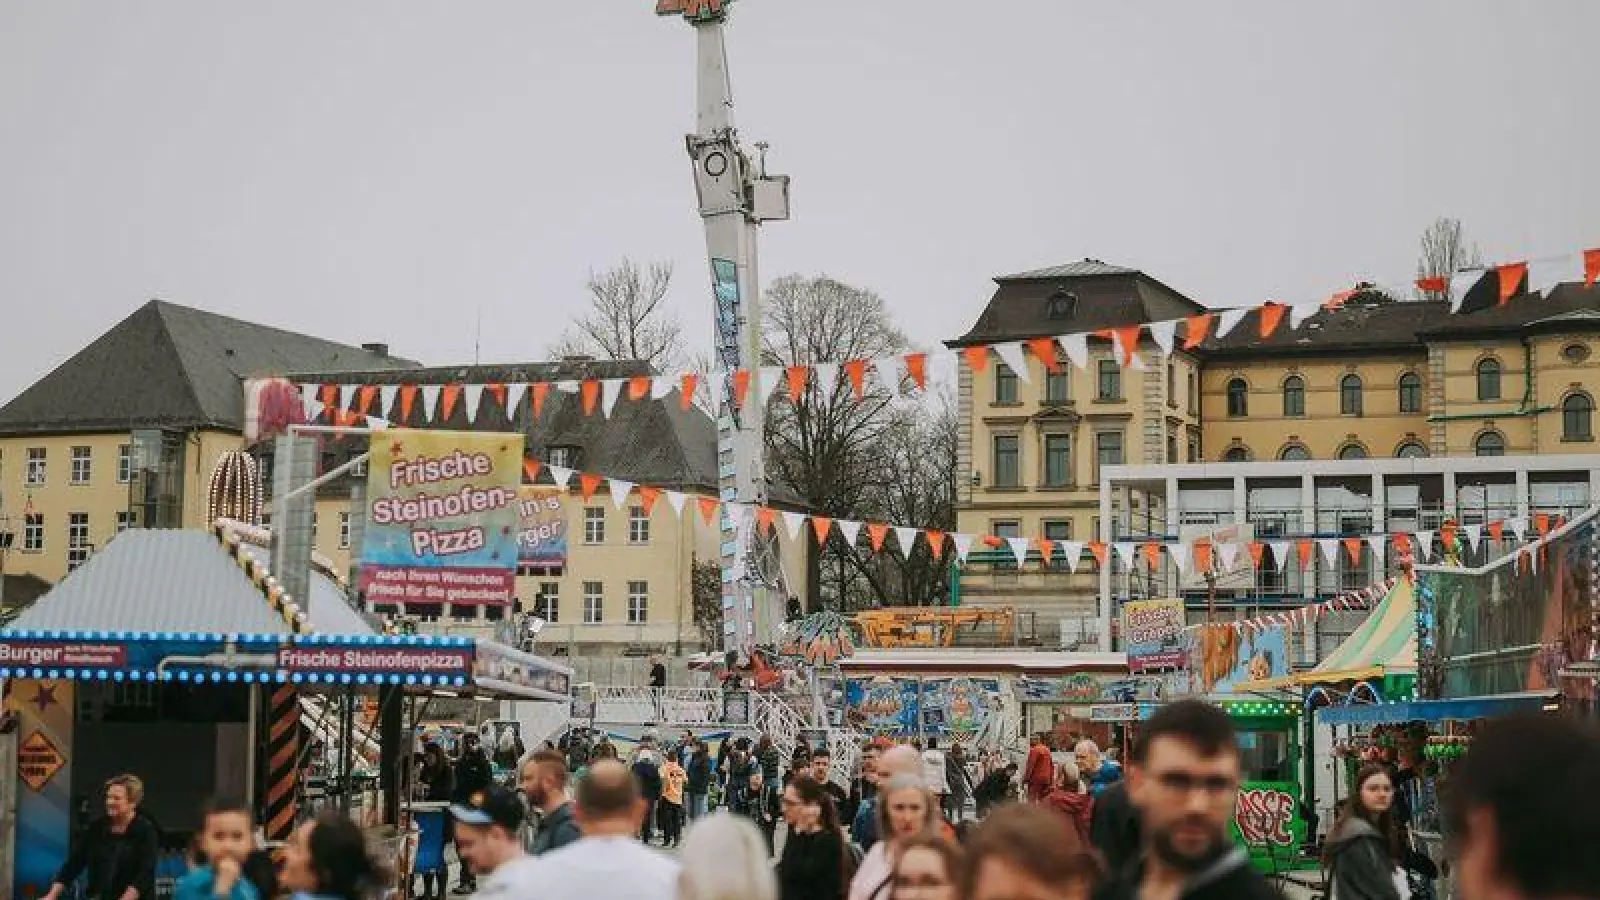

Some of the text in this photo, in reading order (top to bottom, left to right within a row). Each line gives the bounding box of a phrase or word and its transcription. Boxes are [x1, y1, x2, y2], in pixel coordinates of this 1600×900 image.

[391, 450, 491, 487] Frische
[373, 485, 515, 523] Steinofen-
[413, 527, 484, 556] Pizza
[516, 521, 560, 547] rger
[0, 644, 62, 665] Burger
[279, 650, 465, 670] Frische Steinofenpizza
